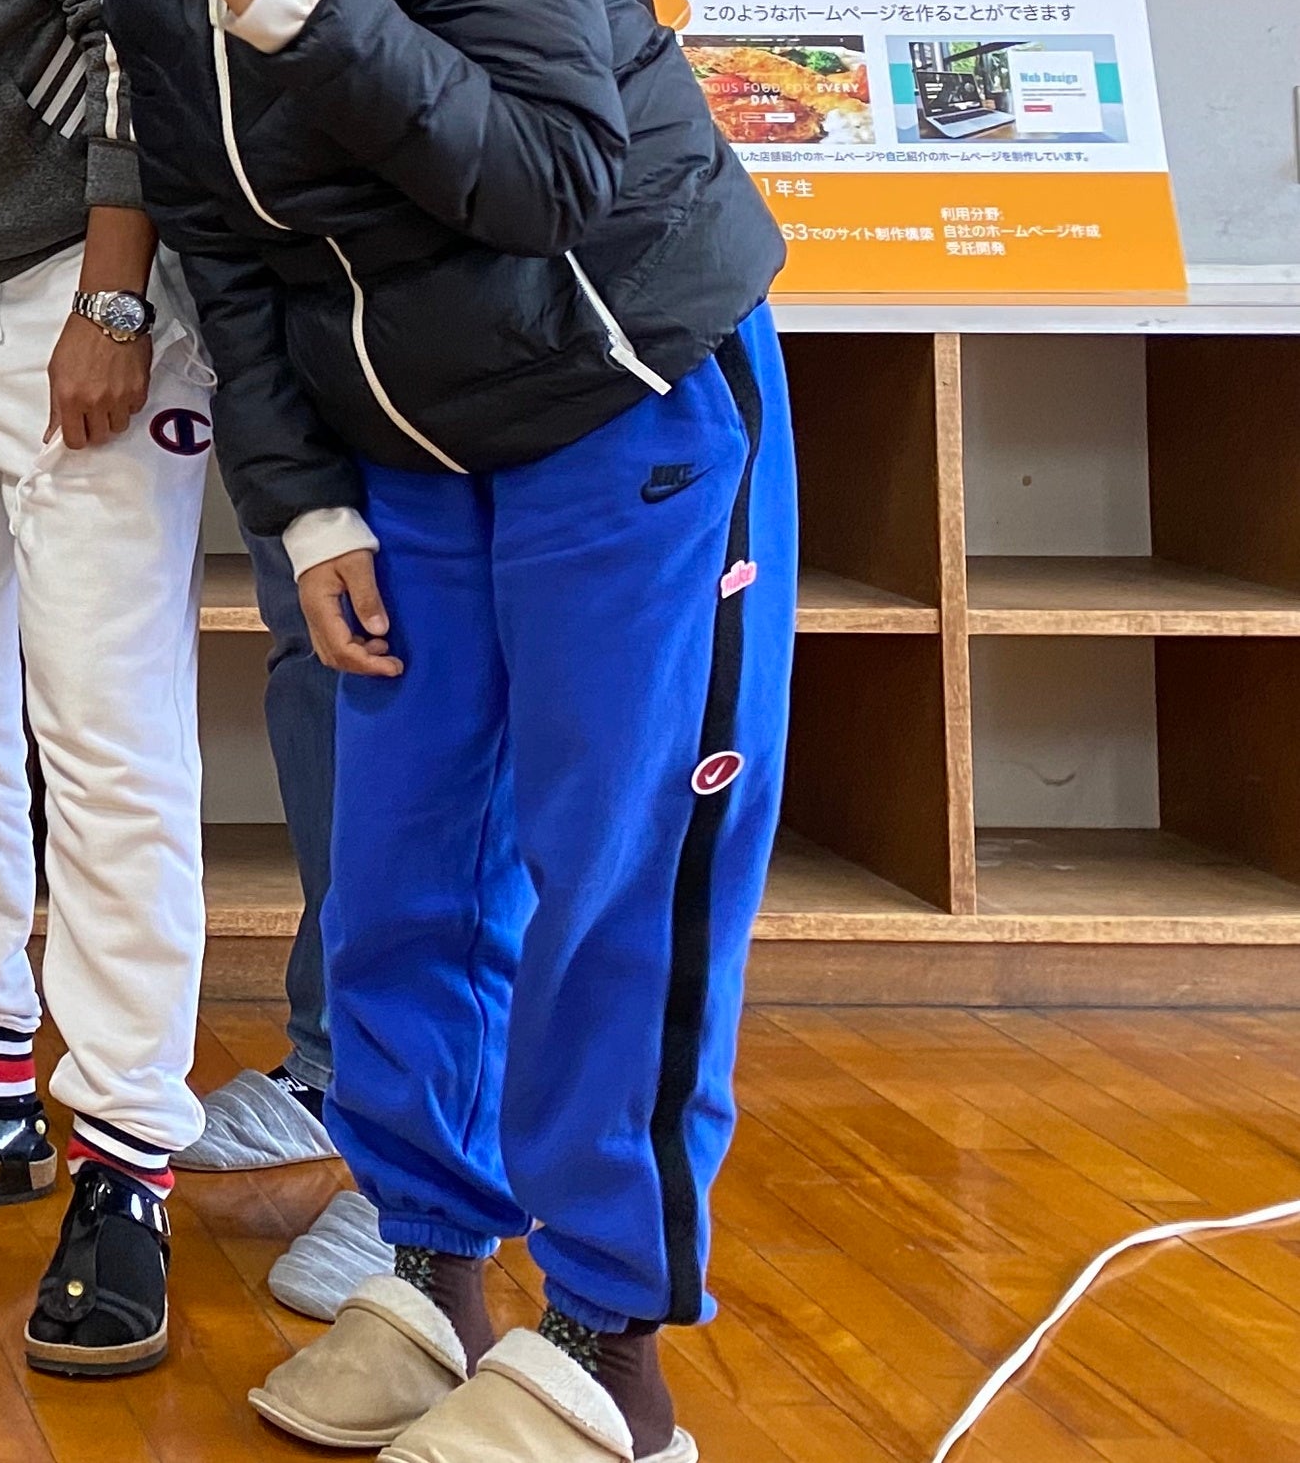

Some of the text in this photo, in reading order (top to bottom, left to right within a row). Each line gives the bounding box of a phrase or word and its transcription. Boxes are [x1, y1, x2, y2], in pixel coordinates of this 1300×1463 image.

[703, 4, 1075, 23] このようなホームページを作ることができます
[1043, 72, 1078, 84] Design
